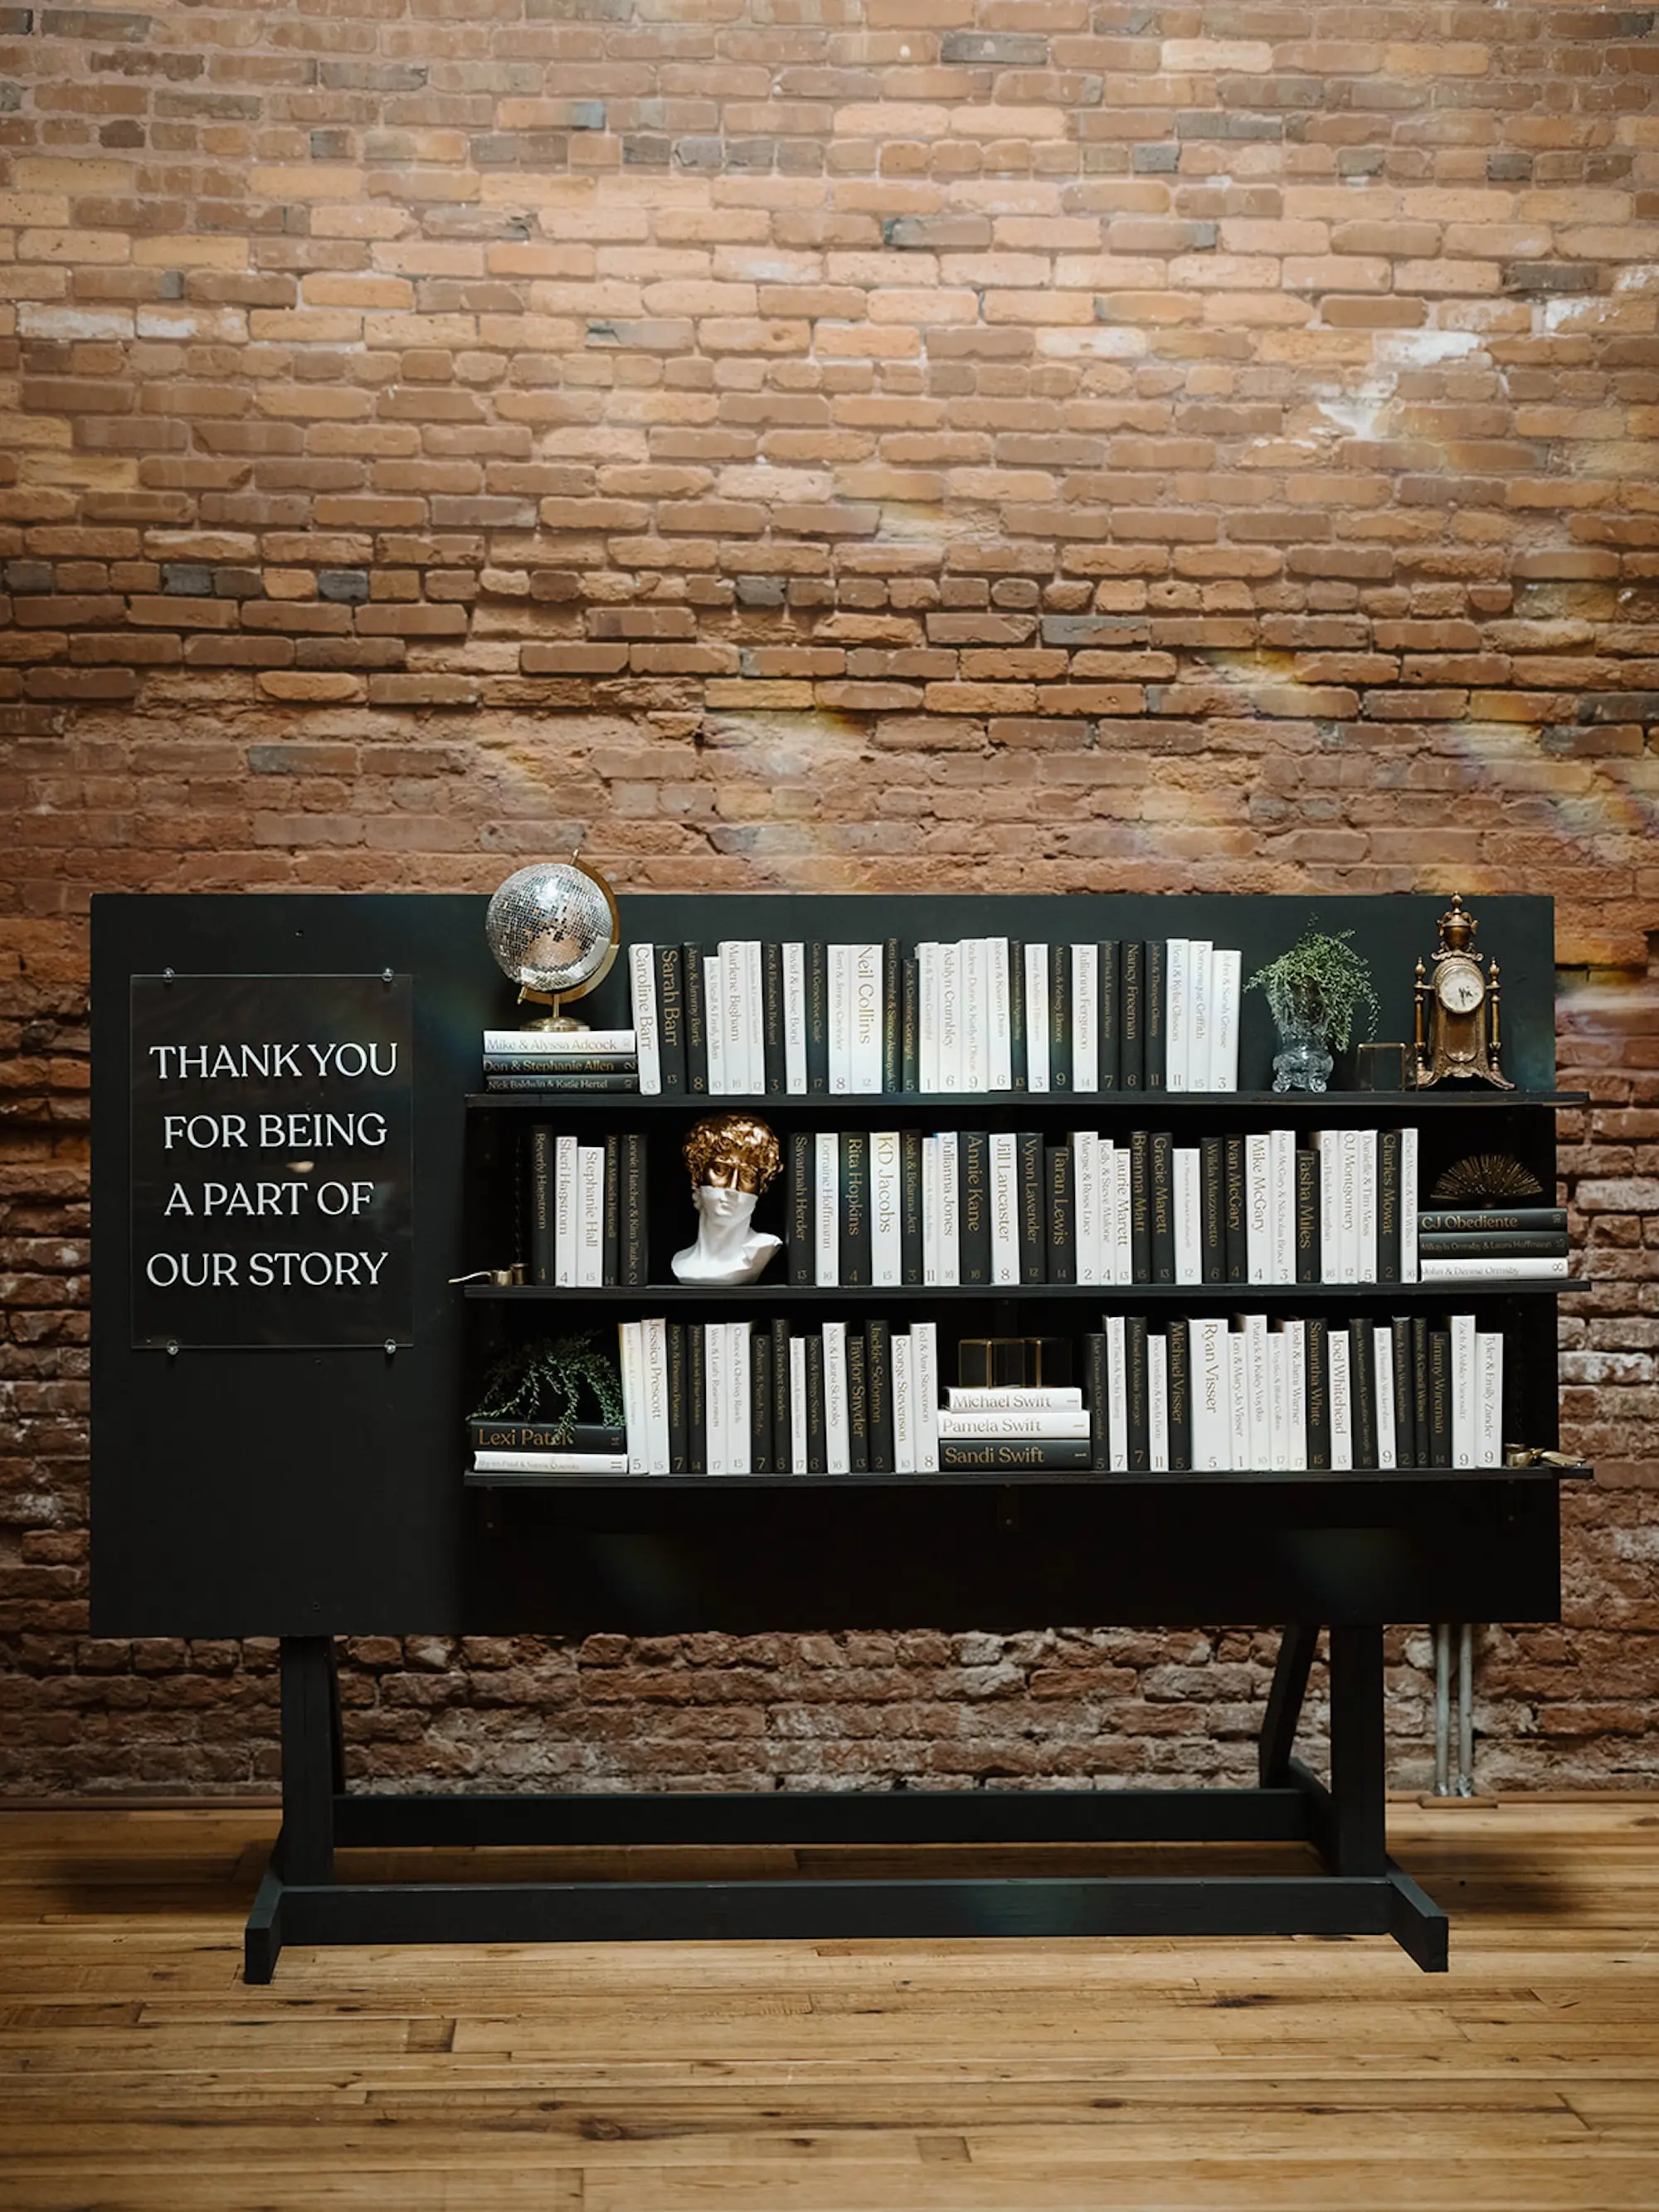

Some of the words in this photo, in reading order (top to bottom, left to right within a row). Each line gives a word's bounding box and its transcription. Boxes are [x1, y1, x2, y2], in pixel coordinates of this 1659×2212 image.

[662, 950, 679, 1003] Sarah
[728, 944, 739, 992] Marlene
[789, 945, 799, 974] David
[858, 946, 874, 979] Neil
[941, 947, 954, 988] Ashlyn
[1079, 947, 1090, 996] Julianna
[1125, 944, 1138, 984] Nancy
[635, 946, 651, 1011] Caroline
[789, 976, 798, 985] &
[729, 994, 742, 1042] Bigham
[789, 987, 799, 1014] Jesse
[858, 984, 874, 1044] Collins
[1126, 986, 1138, 1040] Freeman
[639, 1016, 654, 1050] Barr
[664, 1007, 681, 1047] Barr
[790, 1018, 800, 1045] Bond
[943, 990, 956, 1049] Crumbley
[1079, 999, 1092, 1050] Ferguson
[1195, 1004, 1206, 1039] Griffith
[148, 1044, 302, 1078] THANK
[308, 1043, 398, 1077] YOU
[487, 1039, 516, 1050] Mike
[518, 1040, 528, 1049] &
[530, 1039, 570, 1052] Alyssa
[570, 1039, 618, 1050] Adcock
[484, 1061, 508, 1072] Don
[510, 1061, 521, 1072] &
[523, 1060, 582, 1073] Stephanie
[585, 1060, 615, 1071] Allen
[693, 1077, 703, 1090] 8
[836, 1077, 845, 1090] 8
[946, 1075, 954, 1087] 6
[969, 1076, 978, 1088] 9
[997, 1074, 1005, 1086] 6
[1034, 1077, 1043, 1088] 3
[1055, 1072, 1066, 1086] 9
[1104, 1075, 1113, 1087] 7
[1127, 1075, 1136, 1087] 6
[1218, 1077, 1227, 1088] 3
[770, 1079, 779, 1091] 3
[163, 1115, 248, 1149] FOR
[259, 1112, 388, 1147] BEING
[534, 1133, 547, 1172] Beverly
[560, 1139, 572, 1170] Sheri
[795, 1136, 808, 1196] Savannah
[821, 1137, 833, 1186] Lorraine
[848, 1139, 863, 1168] Rita
[877, 1136, 893, 1164] KD
[942, 1136, 954, 1194] Julianna
[967, 1135, 984, 1185] Annie
[996, 1138, 1011, 1160] Jill
[1022, 1139, 1038, 1179] Vyron
[1132, 1134, 1147, 1194] Brianna
[1154, 1137, 1167, 1184] Gracie
[1228, 1140, 1240, 1169] Ivan
[1252, 1138, 1265, 1173] Mike
[1383, 1134, 1396, 1185] Charles
[583, 1151, 598, 1218] Stephanie
[1053, 1149, 1069, 1194] Taran
[1117, 1151, 1128, 1195] Laurie
[1300, 1152, 1315, 1201] Tasha
[163, 1183, 194, 1216] A
[203, 1183, 308, 1216] PART
[317, 1181, 375, 1215] OF
[536, 1174, 547, 1229] Hagstrom
[558, 1173, 571, 1235] Hagstrom
[844, 1172, 863, 1237] Hopkins
[878, 1169, 895, 1233] Jacobs
[967, 1189, 984, 1232] Kane
[997, 1165, 1011, 1242] Lancaster
[1155, 1186, 1168, 1234] Marett
[1228, 1173, 1242, 1231] McGary
[1251, 1176, 1267, 1233] McGary
[1342, 1154, 1355, 1232] Montgomery
[795, 1198, 808, 1241] Herder
[821, 1189, 834, 1249] Hoffmann
[943, 1195, 956, 1236] Jones
[1025, 1182, 1040, 1244] Lavender
[1053, 1198, 1068, 1246] Lewis
[1117, 1198, 1129, 1246] Marett
[1134, 1197, 1147, 1232] Matt
[1300, 1204, 1315, 1249] Miles
[1382, 1188, 1395, 1234] Mowat
[1422, 1216, 1441, 1230] CJ
[1444, 1215, 1519, 1228] Obediente
[586, 1221, 598, 1247] Hall
[146, 1253, 239, 1287] OUR
[249, 1252, 388, 1286] STORY
[559, 1271, 568, 1283] 4
[629, 1272, 638, 1285] 2
[849, 1270, 858, 1282] 4
[1001, 1268, 1010, 1281] 8
[1083, 1268, 1092, 1280] 2
[1102, 1269, 1111, 1281] 4
[1210, 1267, 1219, 1279] 6
[1254, 1268, 1262, 1280] 4
[1364, 1270, 1373, 1280] 5
[1385, 1266, 1394, 1278] 2
[649, 1320, 660, 1364] Jessica
[870, 1324, 882, 1363] Jackie
[896, 1338, 907, 1378] George
[1170, 1323, 1185, 1378] Michael
[1201, 1324, 1218, 1362] Ryan
[1233, 1336, 1243, 1354] Len
[1310, 1321, 1324, 1386] Samantha
[1332, 1336, 1345, 1362] Joel
[1432, 1334, 1444, 1378] Jimmy
[1485, 1335, 1495, 1359] Tyler
[849, 1339, 864, 1383] Taylor
[1233, 1357, 1243, 1365] &
[1233, 1366, 1243, 1391] Mary
[1486, 1361, 1495, 1370] &
[650, 1368, 662, 1420] Prescott
[871, 1366, 883, 1424] Solomon
[953, 1395, 1010, 1408] Michael
[1013, 1395, 1052, 1407] Swift
[1172, 1379, 1185, 1424] Visser
[1205, 1364, 1219, 1413] Visser
[1234, 1393, 1243, 1405] Jo
[1333, 1364, 1346, 1434] Whitehead
[1482, 1373, 1495, 1400] Emily
[850, 1386, 866, 1437] Snyder
[897, 1381, 907, 1441] Stevenson
[1235, 1407, 1244, 1437] Visser
[1311, 1387, 1325, 1427] White
[1433, 1378, 1446, 1434] Wireman
[1485, 1403, 1494, 1438] Zander
[479, 1428, 516, 1446] Lexi
[521, 1428, 572, 1446] Pat
[942, 1419, 999, 1433] Pamela
[1002, 1418, 1042, 1432] Swift
[674, 1456, 684, 1470] 7
[756, 1456, 765, 1470] 7
[925, 1456, 934, 1467] 8
[945, 1446, 994, 1464] Sandi
[998, 1446, 1045, 1464] Swift
[1115, 1454, 1123, 1467] 7
[1134, 1450, 1143, 1463] 7
[1209, 1457, 1217, 1468] 5
[1382, 1450, 1392, 1463] 9
[1459, 1453, 1468, 1466] 9
[1485, 1451, 1494, 1463] 9
